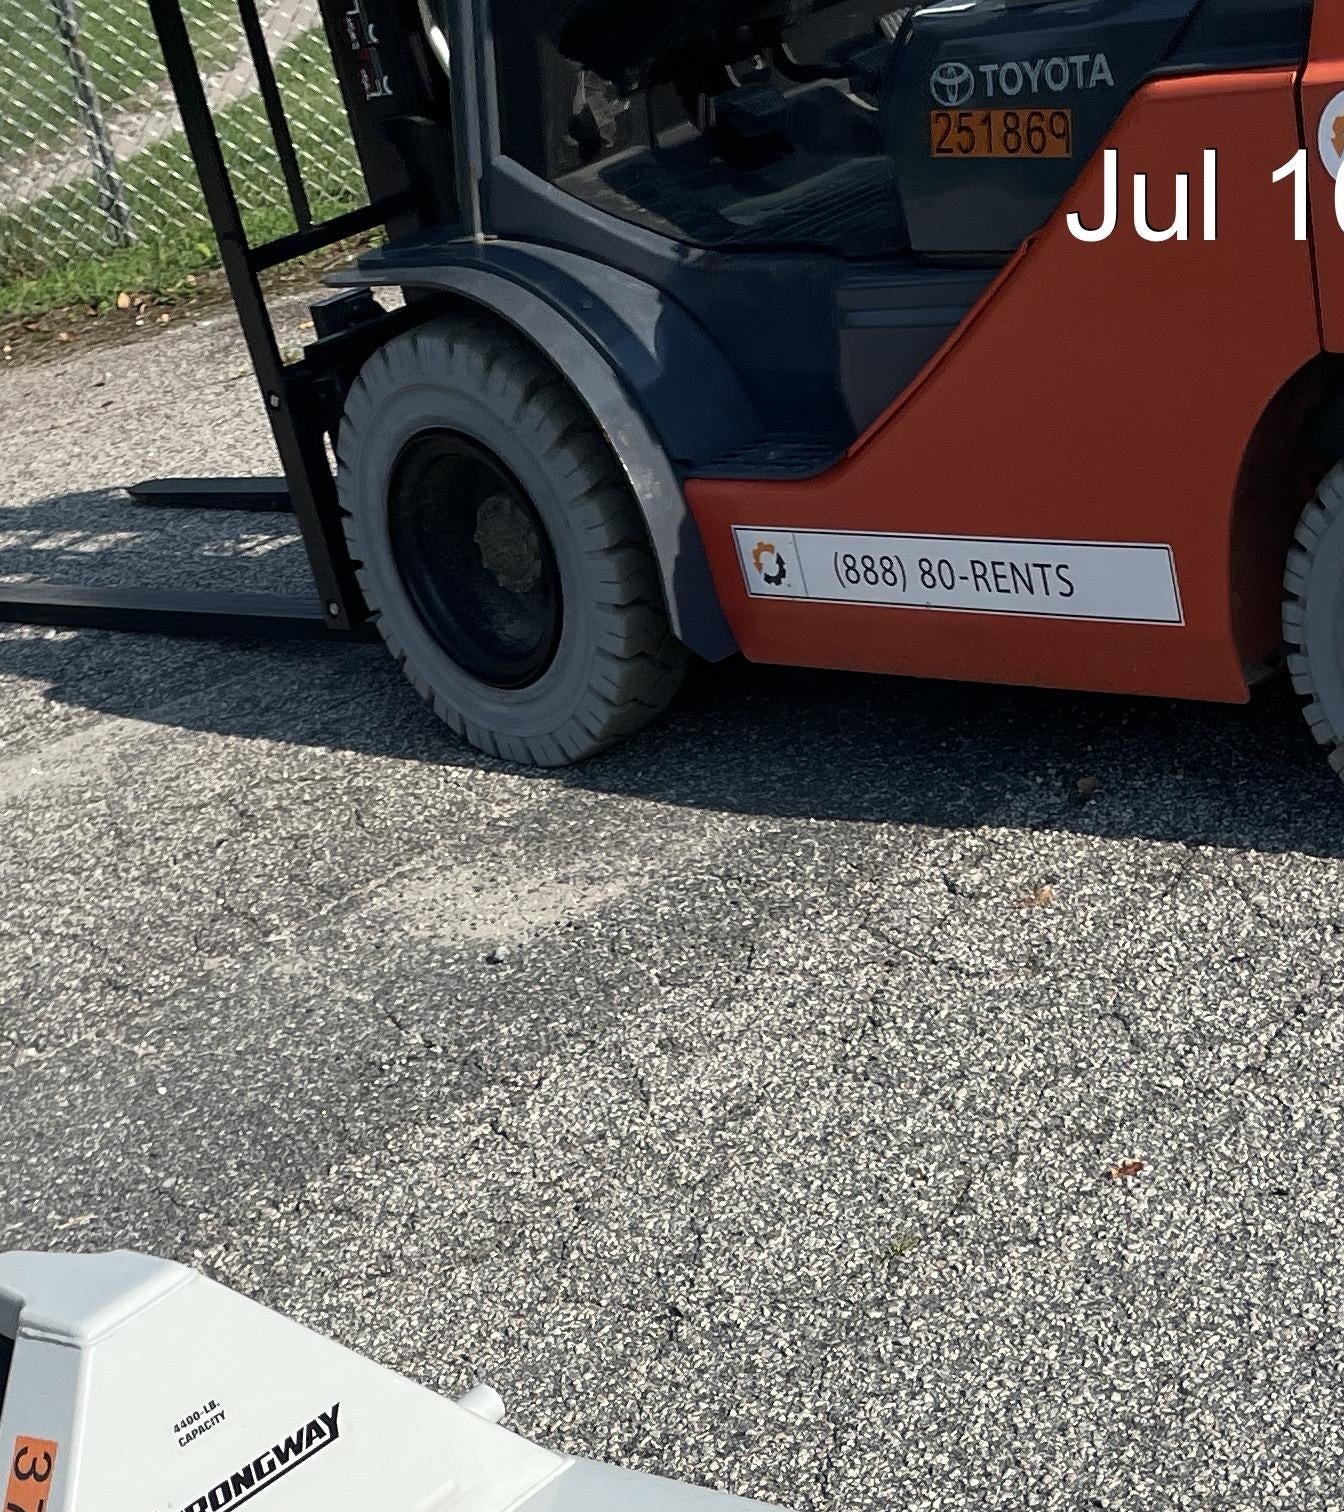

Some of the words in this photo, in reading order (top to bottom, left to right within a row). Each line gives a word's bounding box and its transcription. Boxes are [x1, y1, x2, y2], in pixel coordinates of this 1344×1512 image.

[979, 53, 1115, 97] TOYOTA
[934, 111, 1071, 155] 251869
[834, 551, 907, 593] (888)
[918, 557, 1075, 598] 80-RENTS
[178, 1410, 226, 1447] CAPACITY
